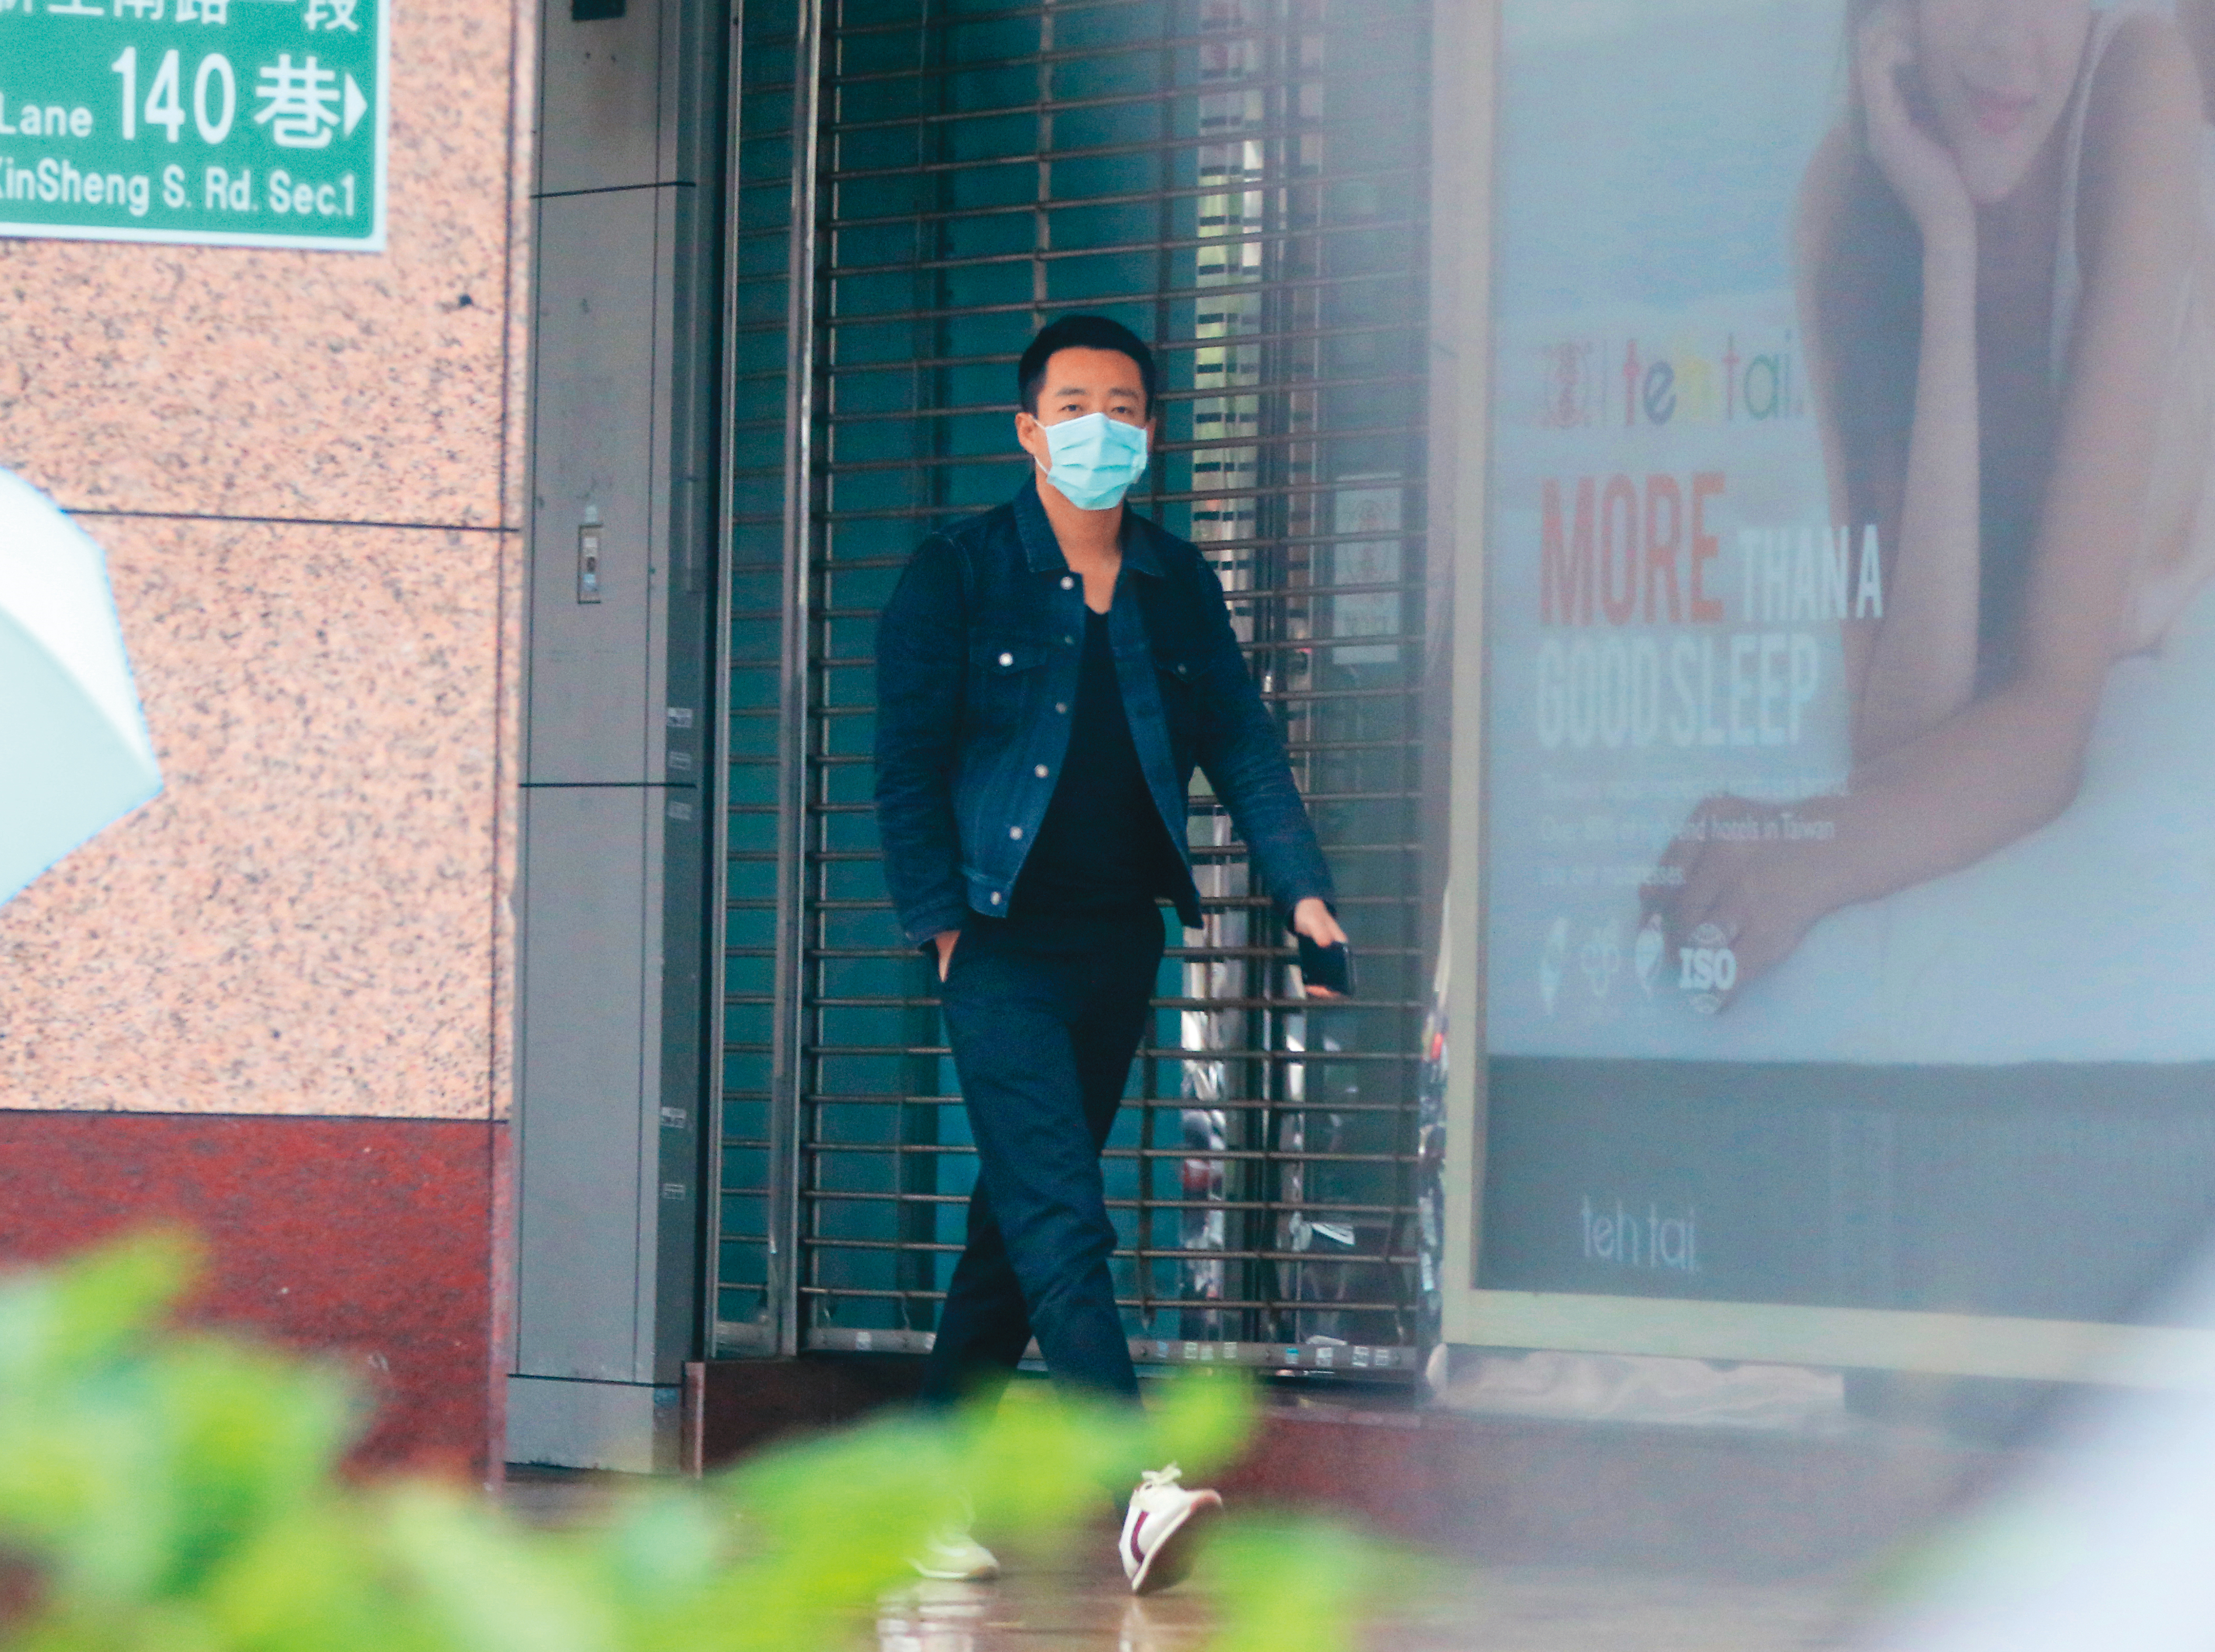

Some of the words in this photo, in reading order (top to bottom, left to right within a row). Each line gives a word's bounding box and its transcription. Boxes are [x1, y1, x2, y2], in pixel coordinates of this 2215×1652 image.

[0, 92, 94, 138] Lane
[112, 46, 236, 144] 140
[254, 54, 341, 148] 巷
[0, 156, 149, 217] inSheng
[163, 164, 193, 208] S.
[205, 166, 259, 211] Rd.
[1540, 472, 1727, 625] MORE
[1536, 636, 1661, 749] GOOD
[1669, 633, 1821, 747] SLEEP
[1679, 946, 1737, 990] ISO
